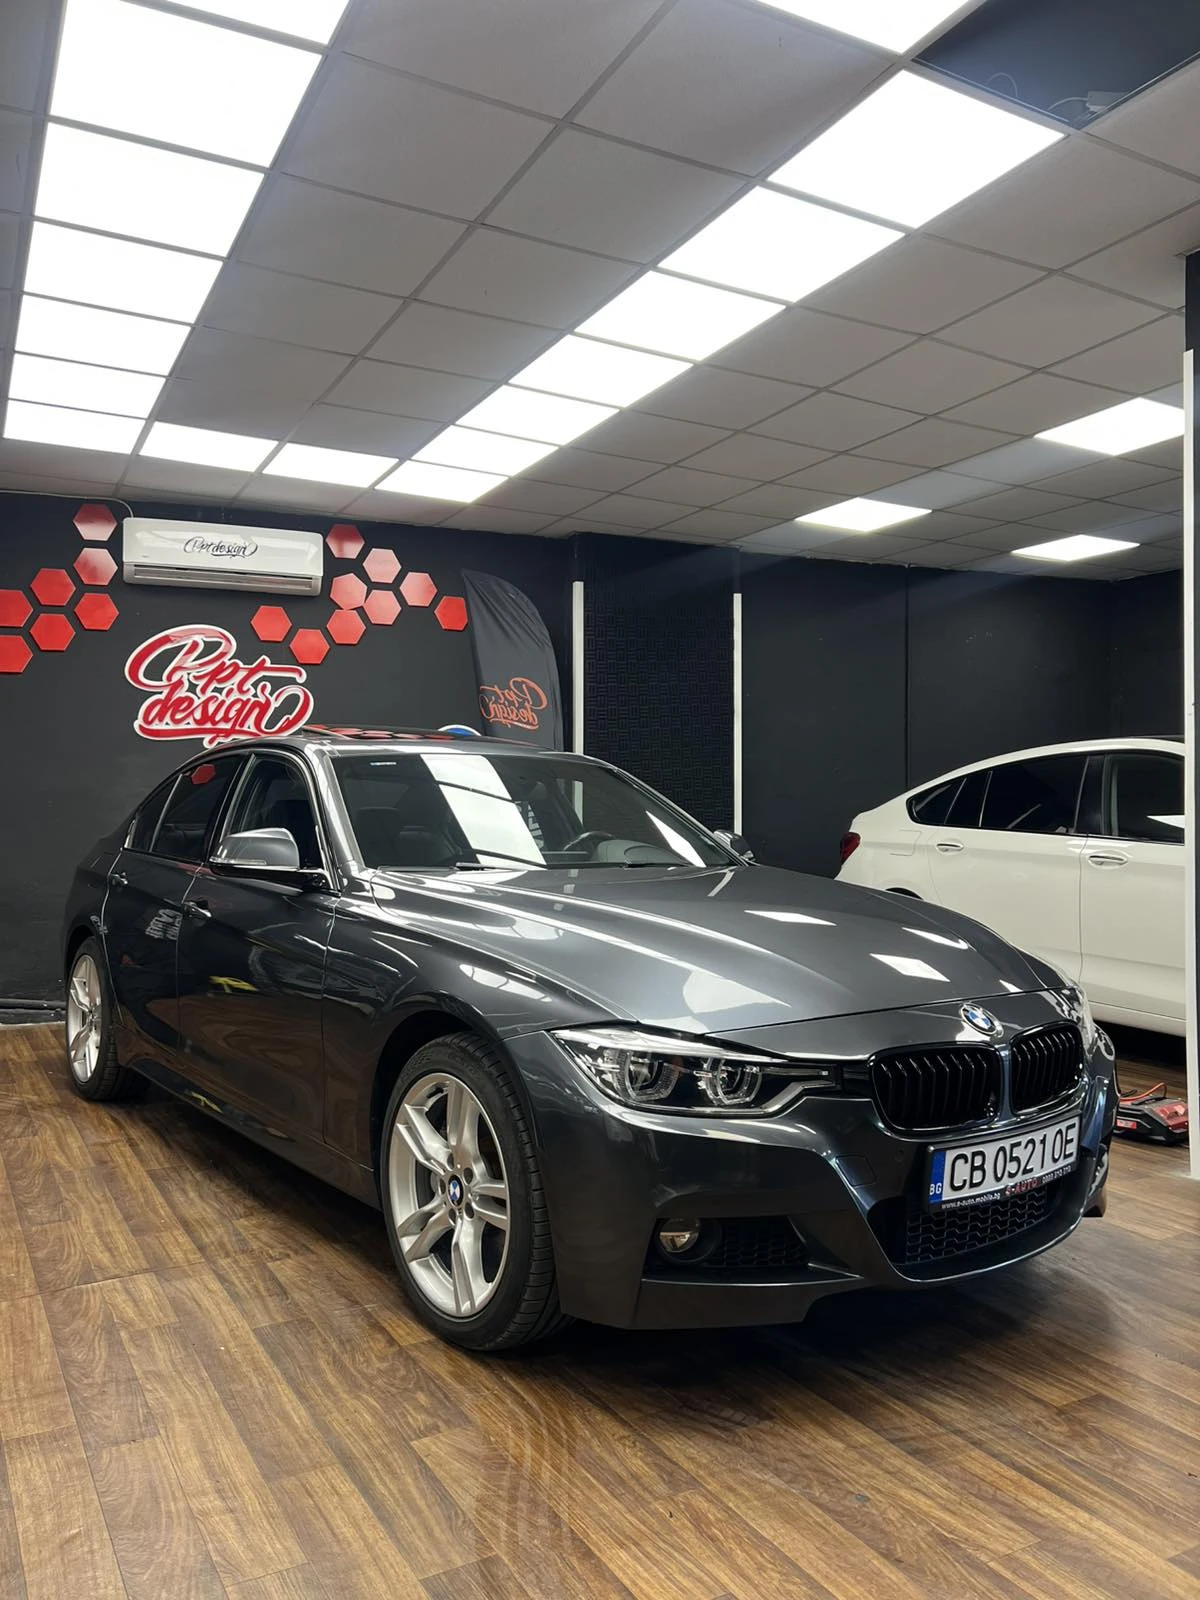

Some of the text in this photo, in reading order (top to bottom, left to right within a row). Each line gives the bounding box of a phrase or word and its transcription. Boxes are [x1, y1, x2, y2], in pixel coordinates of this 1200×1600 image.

[134, 676, 314, 748] design
[929, 1182, 942, 1196] BG
[949, 1150, 987, 1192] CB
[993, 1131, 1047, 1183] 0521
